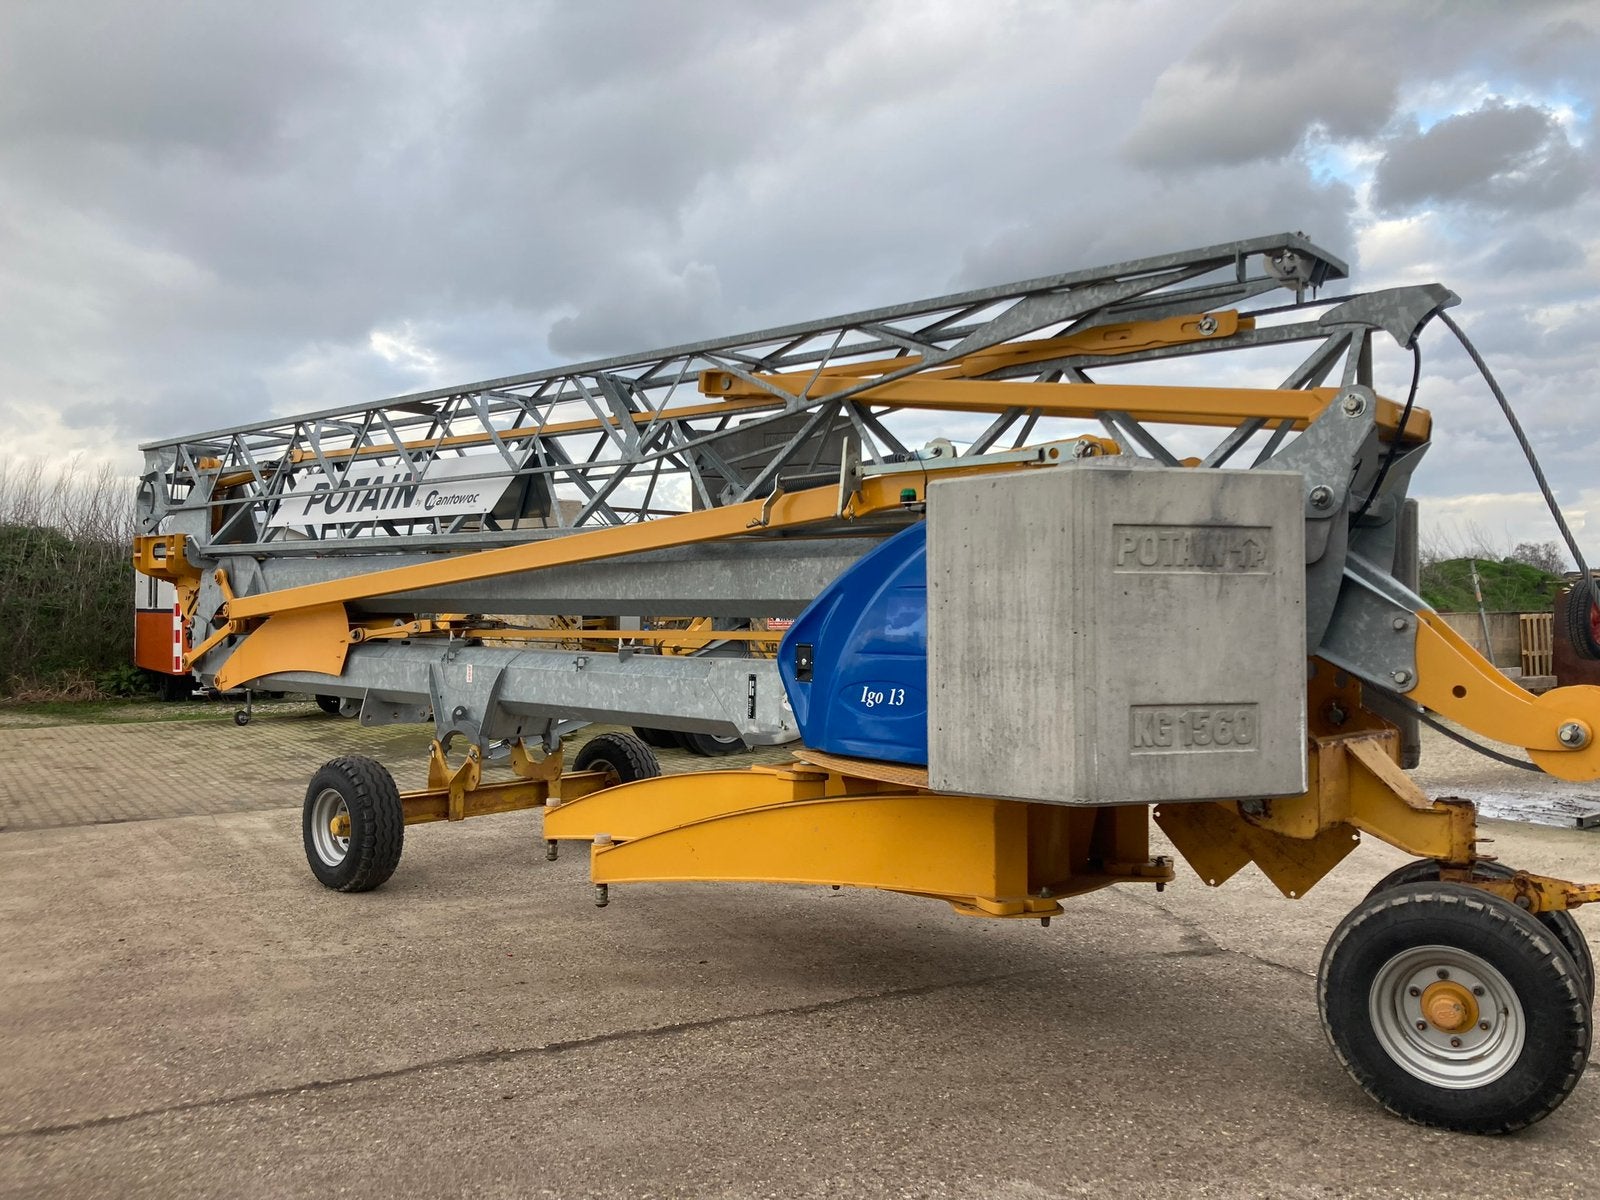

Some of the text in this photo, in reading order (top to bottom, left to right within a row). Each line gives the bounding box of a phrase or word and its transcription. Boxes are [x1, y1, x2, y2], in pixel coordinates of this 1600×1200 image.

[302, 472, 420, 516] POTAIN
[860, 686, 905, 707] Igo 13
